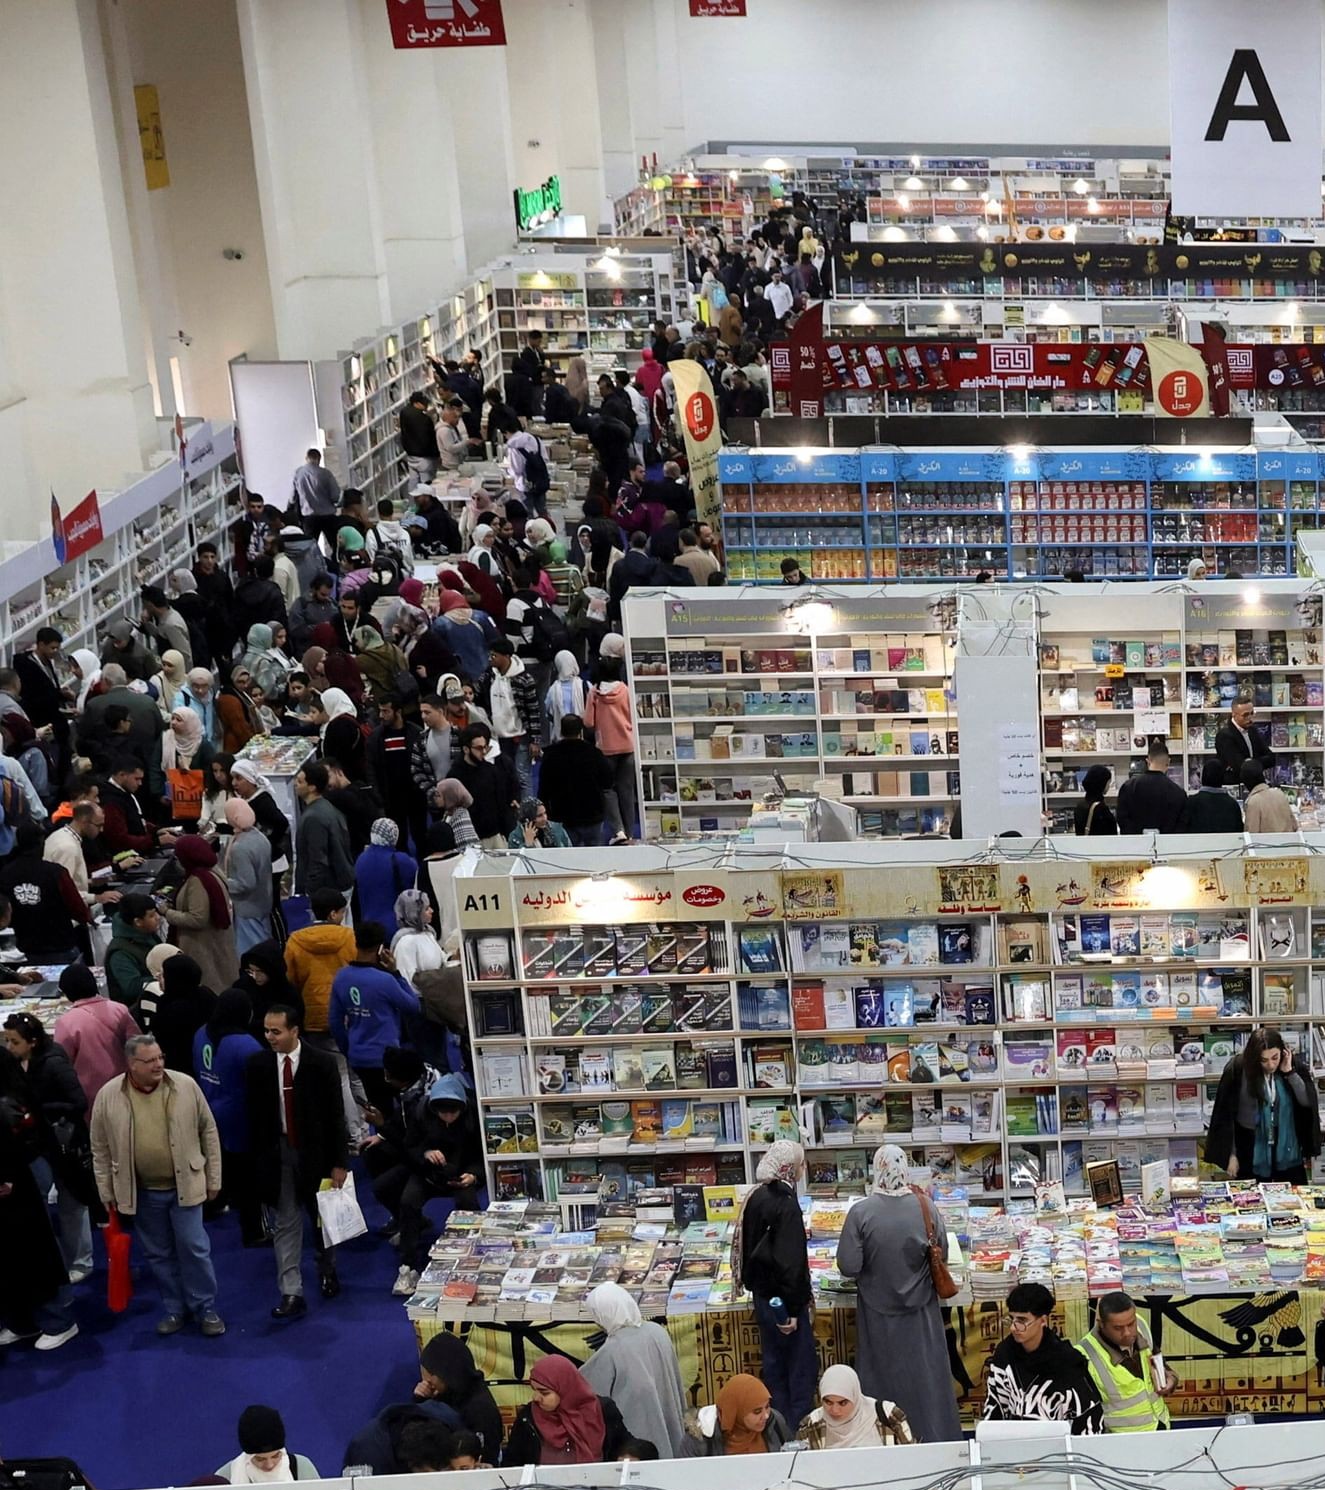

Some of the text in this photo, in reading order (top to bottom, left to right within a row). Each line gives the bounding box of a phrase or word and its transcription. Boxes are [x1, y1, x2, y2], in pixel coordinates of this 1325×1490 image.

[407, 22, 491, 43] طفاية حريق
[1204, 49, 1290, 142] A
[464, 894, 500, 912] A11
